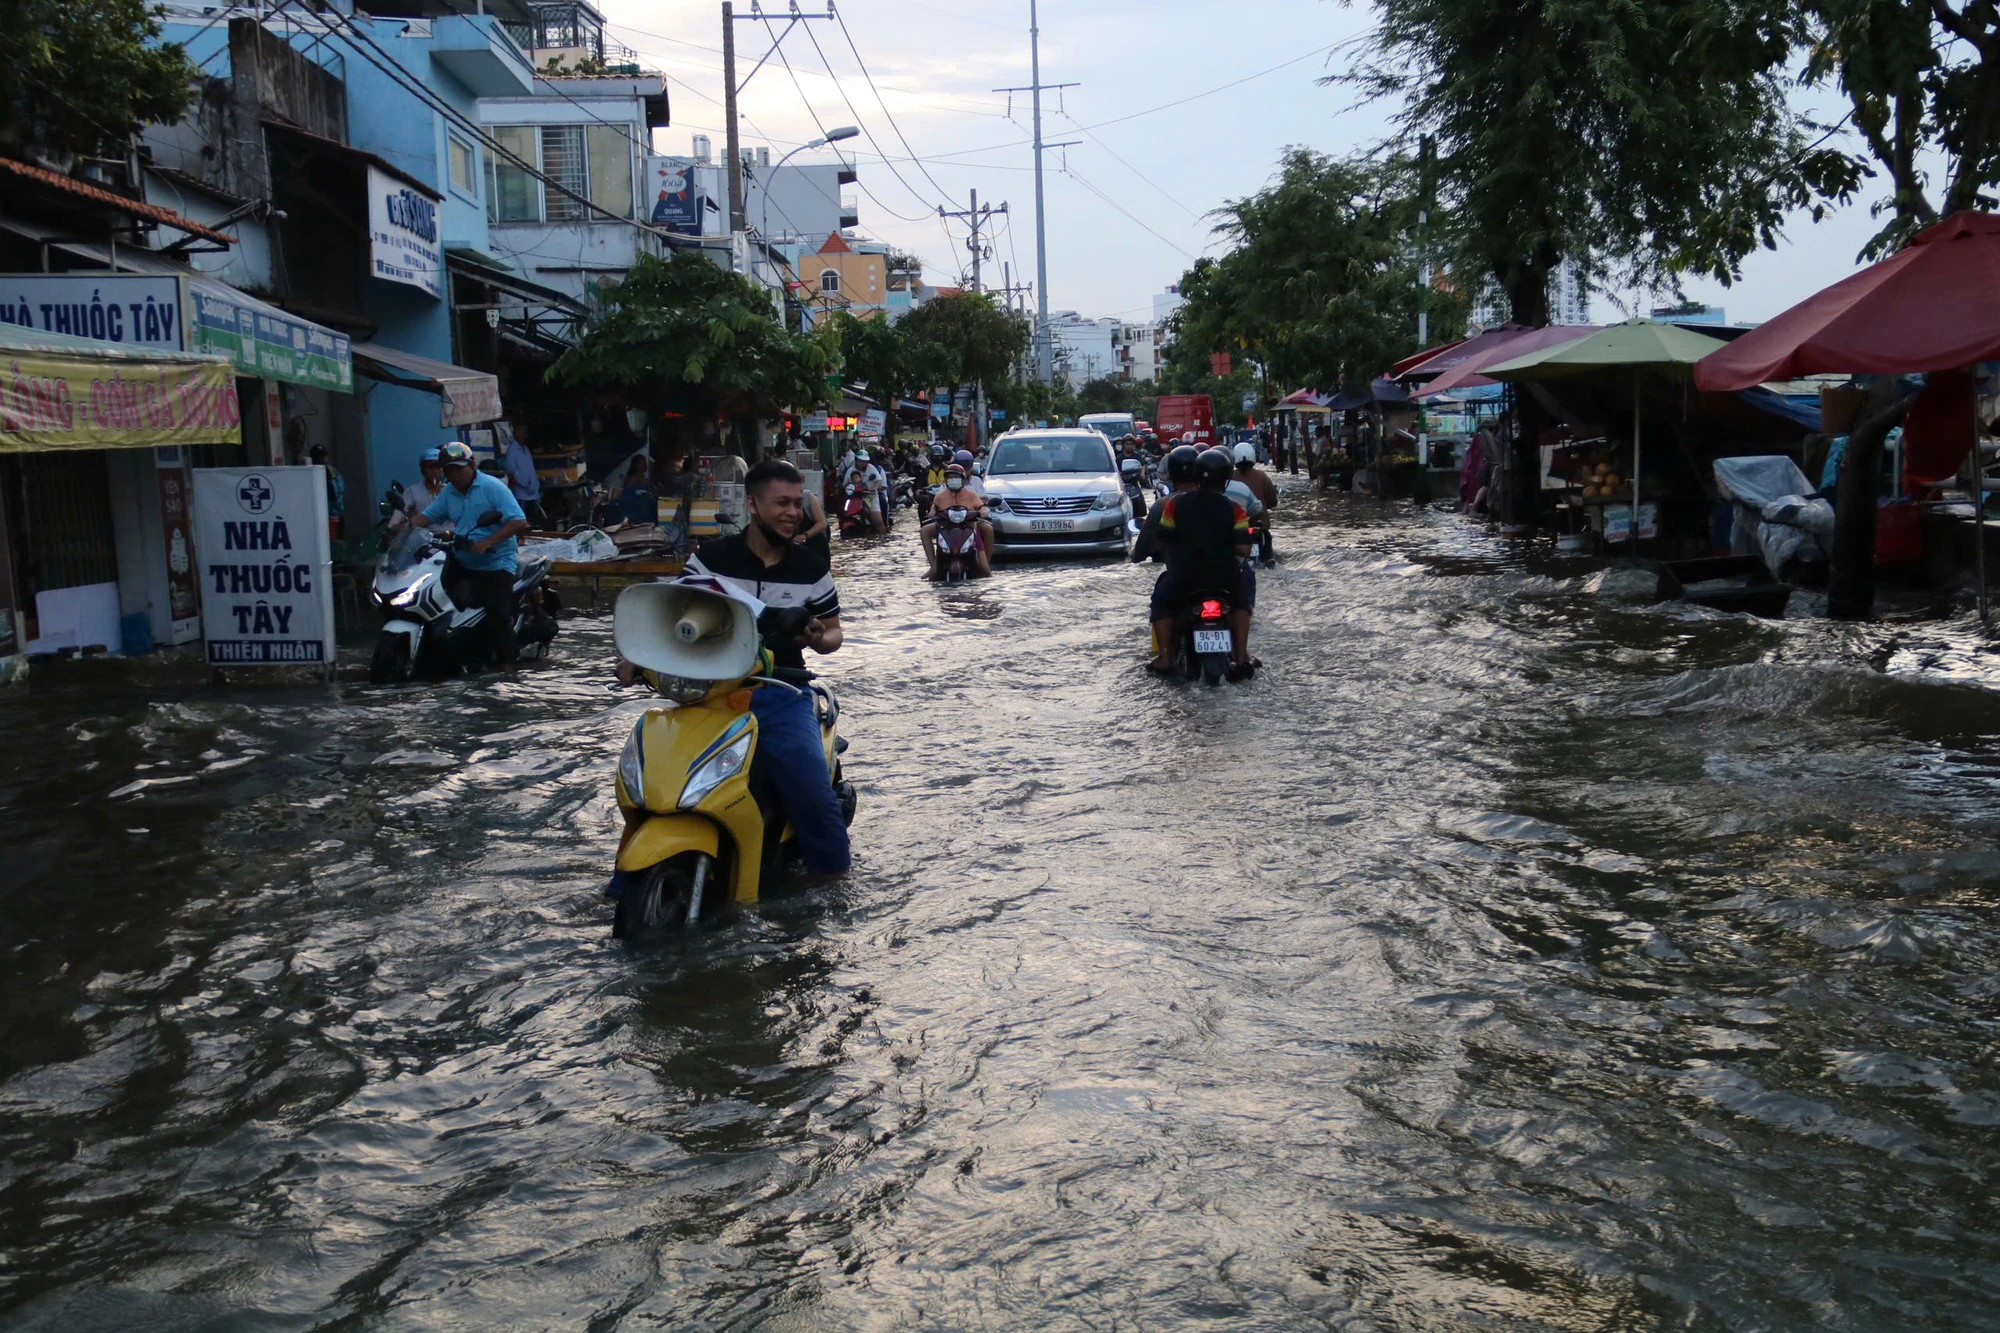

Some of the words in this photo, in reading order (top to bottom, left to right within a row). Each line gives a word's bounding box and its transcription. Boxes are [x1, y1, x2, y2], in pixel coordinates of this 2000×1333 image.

[0, 296, 33, 328] HÀ
[40, 289, 123, 342] THUỐC
[130, 295, 173, 341] TÂY
[224, 516, 292, 550] NHÀ
[209, 554, 311, 593] THUỐC
[232, 600, 293, 634] TÂY
[212, 641, 263, 662] THIỆN
[270, 641, 318, 660] NHÂN
[724, 795, 746, 810] HONDA
